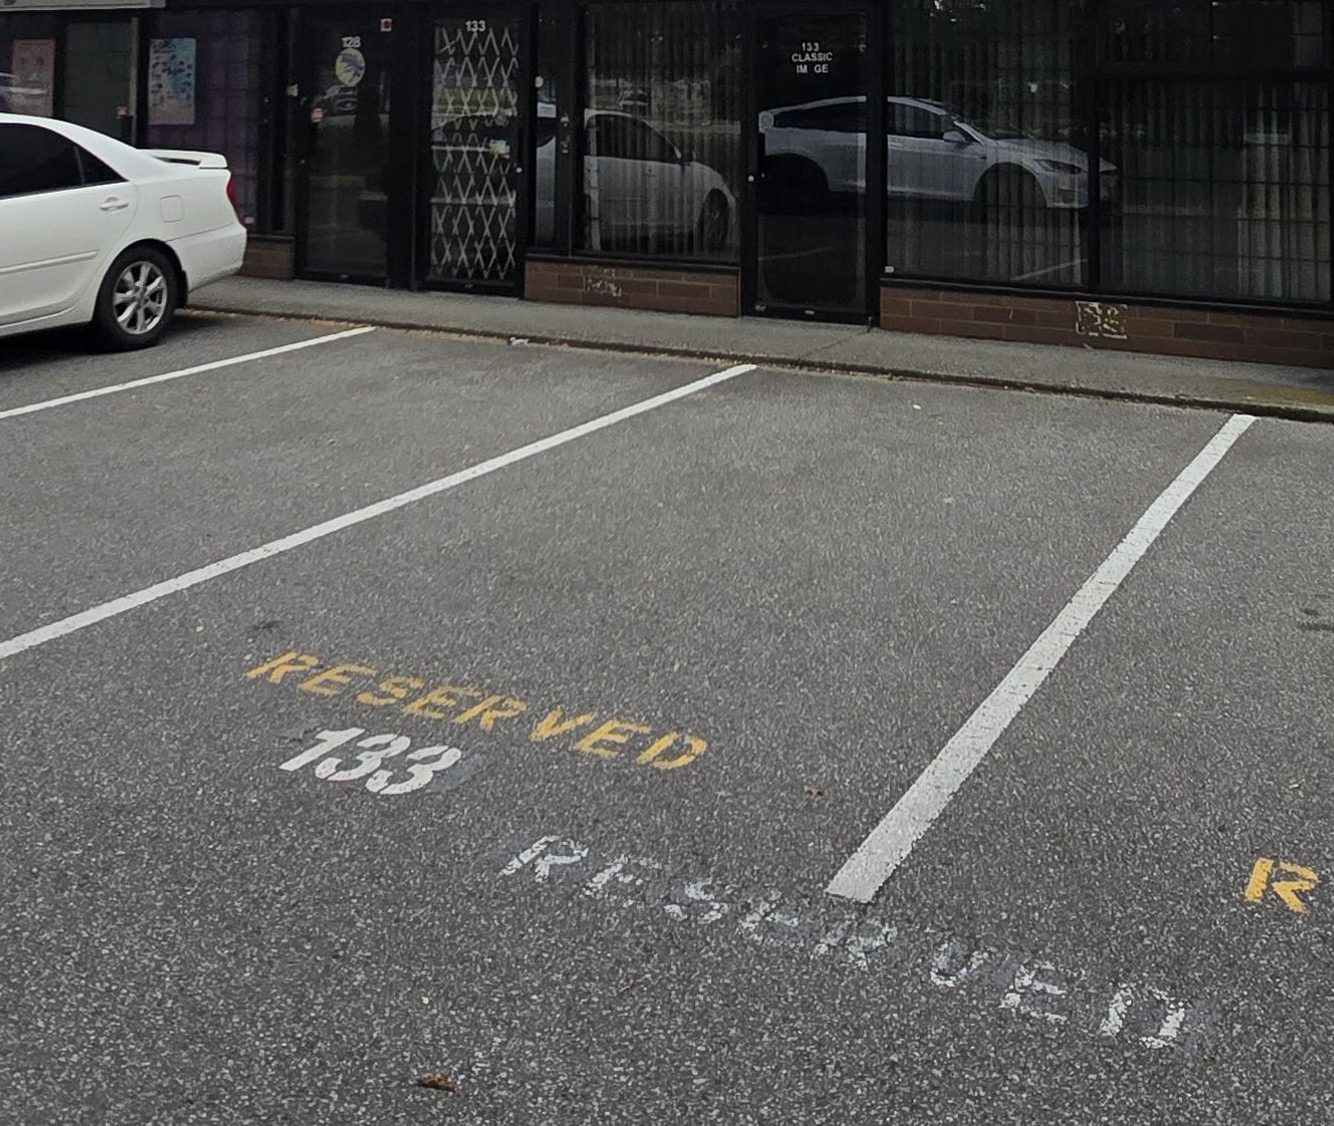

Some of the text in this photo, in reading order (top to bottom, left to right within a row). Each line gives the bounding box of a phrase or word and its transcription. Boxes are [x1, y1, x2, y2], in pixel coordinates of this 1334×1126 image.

[465, 19, 486, 33] 133
[341, 35, 361, 49] 128
[791, 52, 833, 63] CLASSIC
[245, 650, 708, 772] RESERVED
[279, 726, 465, 796] 133
